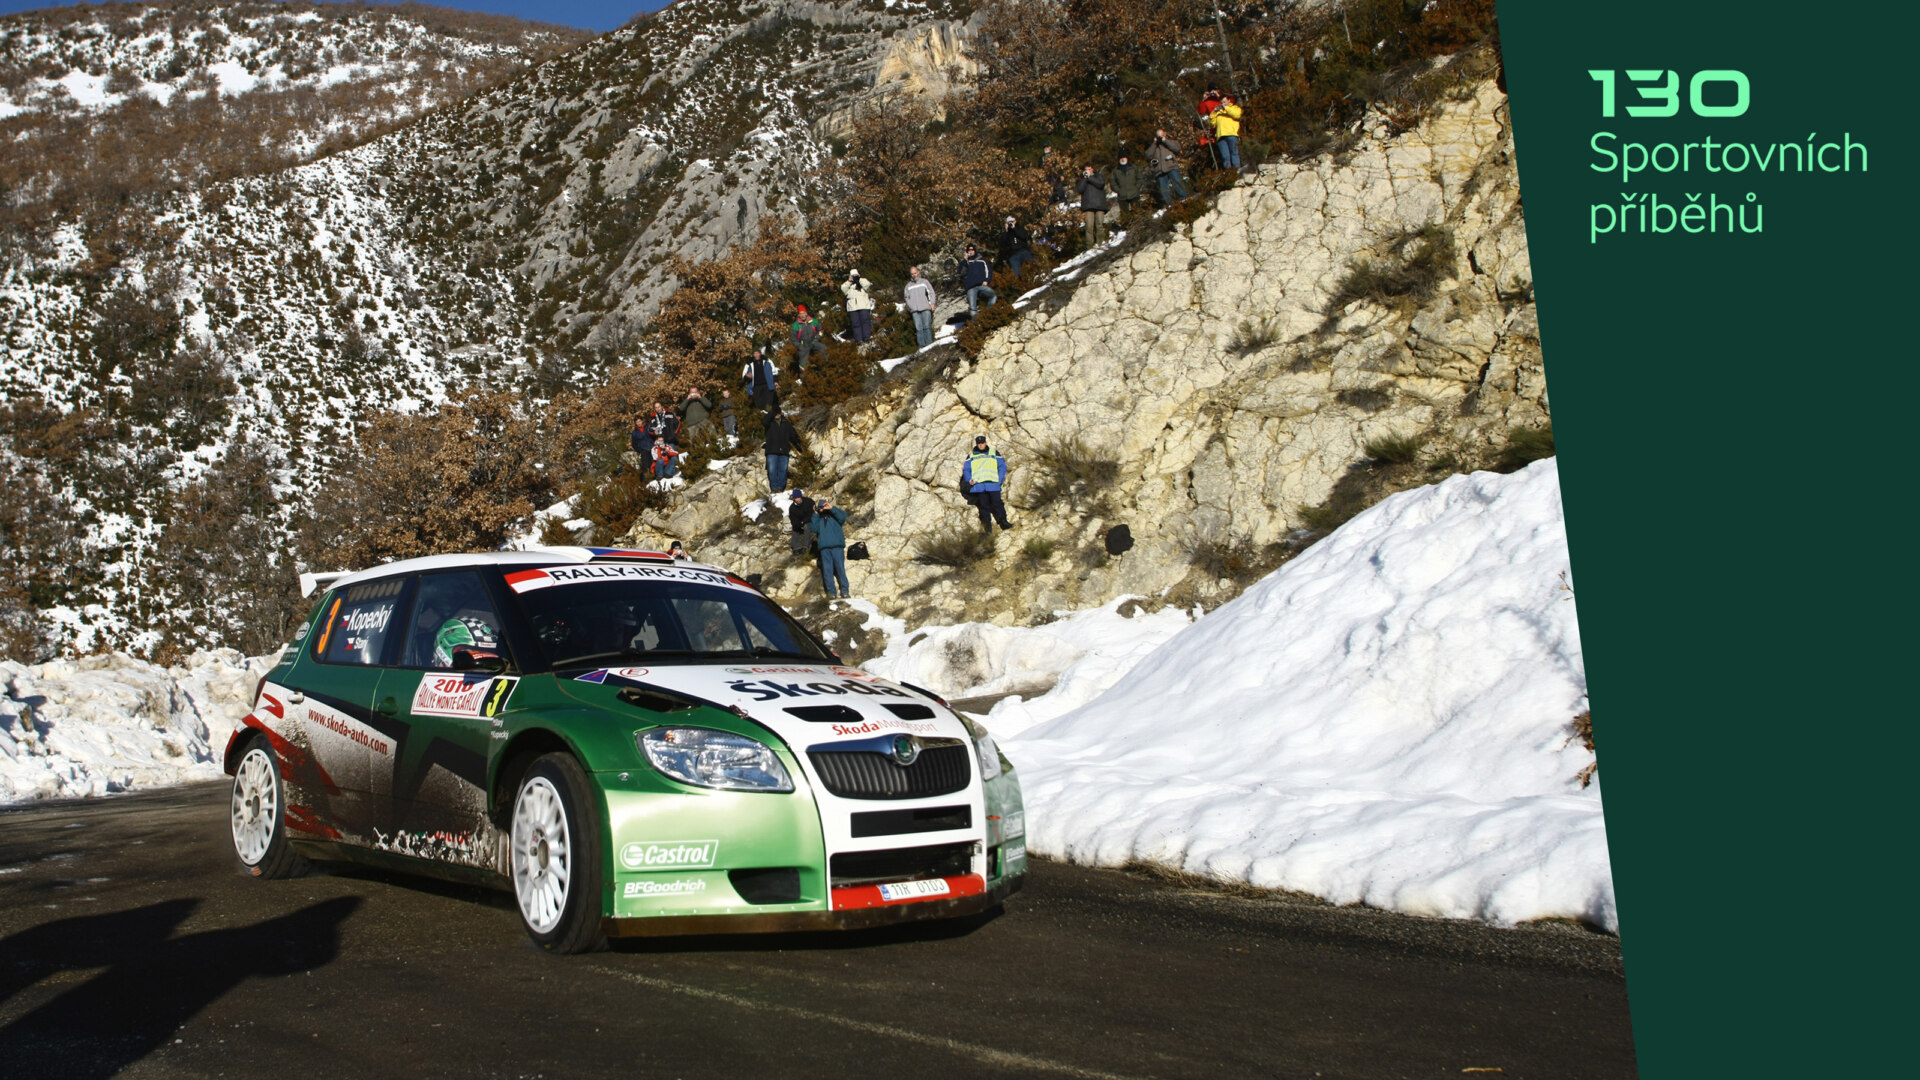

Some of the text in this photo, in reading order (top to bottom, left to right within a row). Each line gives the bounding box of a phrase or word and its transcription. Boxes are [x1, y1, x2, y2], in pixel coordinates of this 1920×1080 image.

[550, 567, 734, 587] RALLY-IRC.COM
[317, 598, 341, 654] 3
[346, 604, 394, 635] Kopecký
[434, 678, 475, 694] 2010
[724, 679, 916, 702] Škoda
[486, 679, 508, 717] 3
[308, 708, 388, 755] www.skoda-auto.com
[644, 844, 710, 865] Castrol
[623, 879, 707, 895] BFGoodrich
